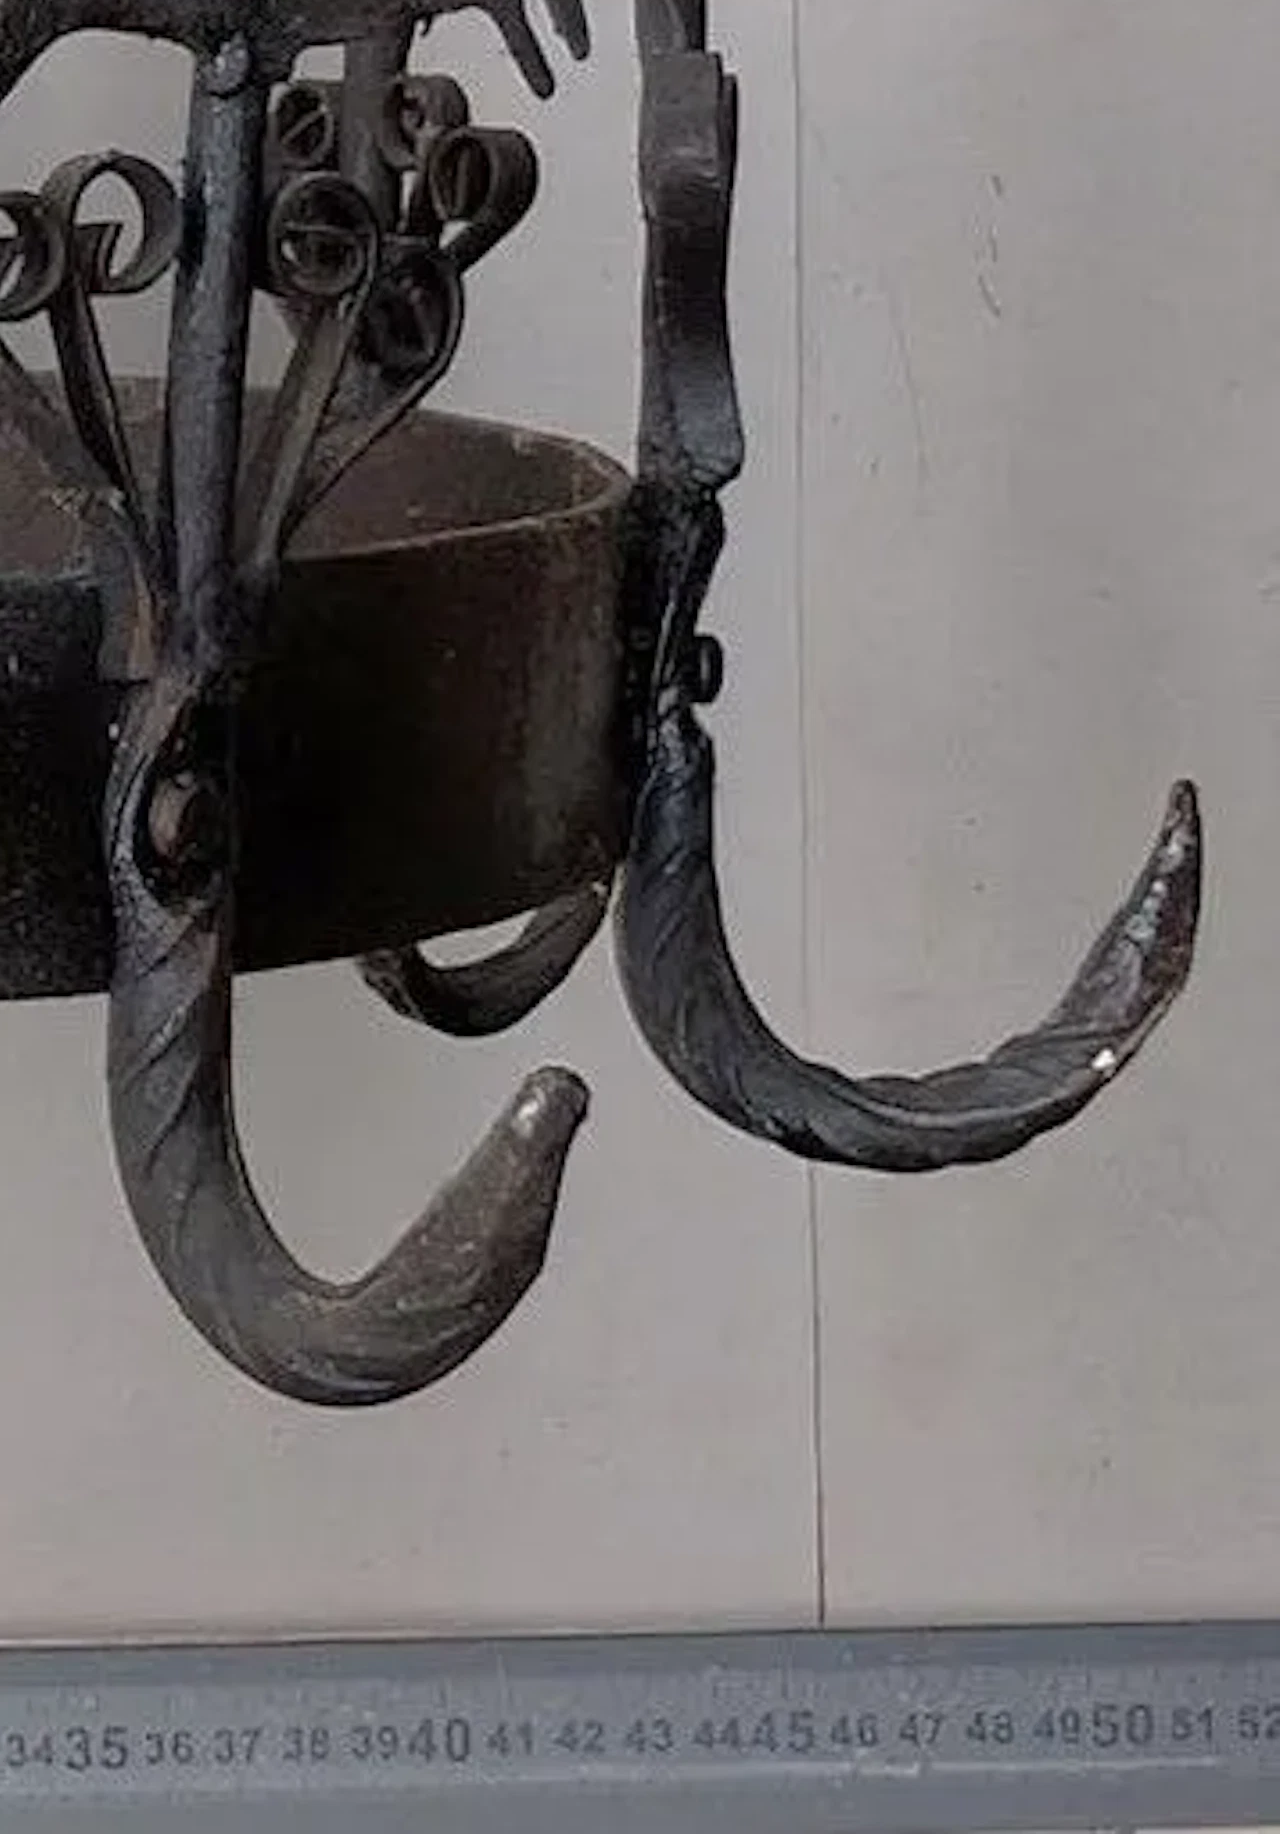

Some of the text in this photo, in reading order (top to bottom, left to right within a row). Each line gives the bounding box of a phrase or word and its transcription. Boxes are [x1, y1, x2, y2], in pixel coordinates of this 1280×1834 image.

[6, 1735, 55, 1769] 34
[65, 1727, 128, 1772] 35
[145, 1731, 192, 1765] 36
[213, 1730, 259, 1764] 37
[282, 1729, 330, 1762] 38
[352, 1726, 400, 1761] 39
[409, 1719, 471, 1764] 40
[487, 1724, 532, 1755] 41
[555, 1721, 604, 1754] 42
[627, 1721, 673, 1753] 43
[695, 1718, 742, 1750] 44
[753, 1711, 815, 1753] 45
[832, 1714, 879, 1747] 46
[899, 1713, 943, 1745] 47
[968, 1711, 1014, 1743] 48
[1035, 1709, 1082, 1742] 49
[1092, 1703, 1154, 1747] 50
